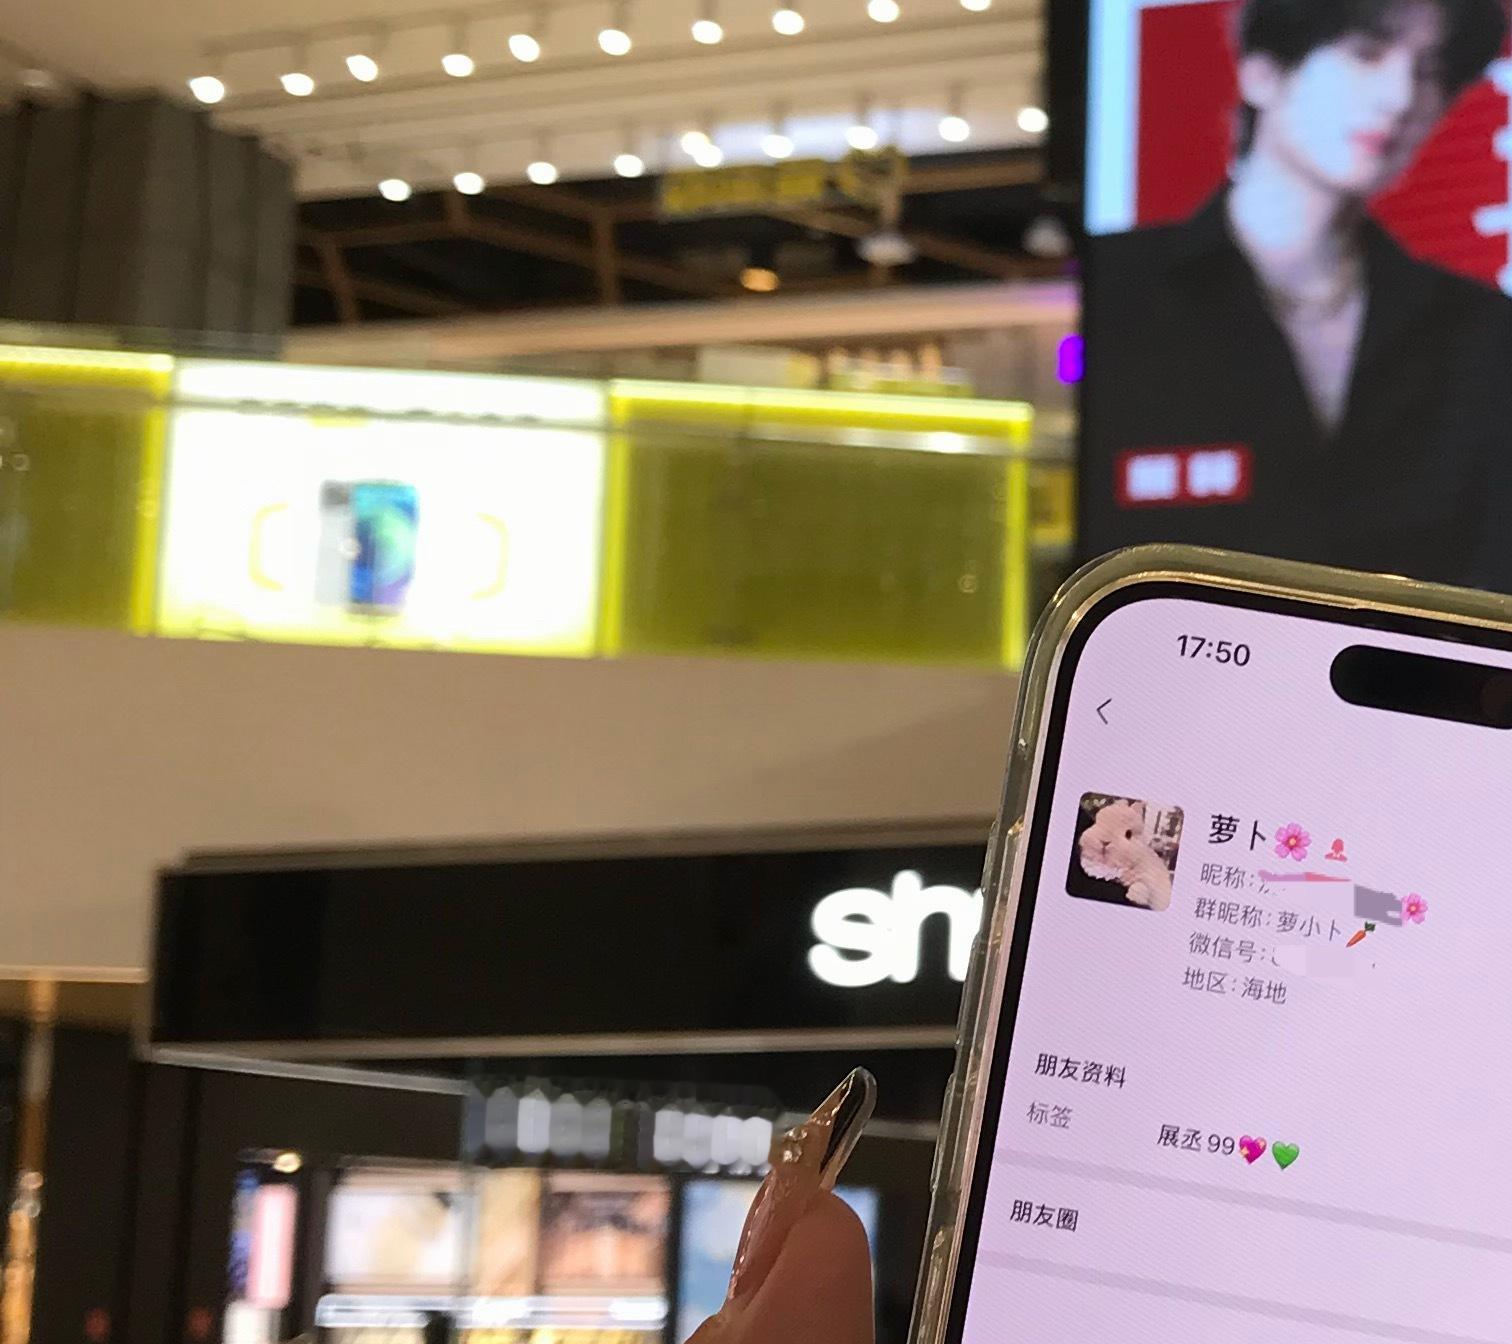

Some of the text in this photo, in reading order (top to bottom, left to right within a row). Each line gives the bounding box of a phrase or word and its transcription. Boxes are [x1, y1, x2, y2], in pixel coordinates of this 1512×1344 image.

[1177, 634, 1251, 667] 17:50
[1207, 813, 1267, 851] 萝卜
[808, 869, 985, 987] sh
[1034, 1053, 1126, 1089] 朋友资料
[1026, 1101, 1073, 1129] 标签
[1009, 1199, 1079, 1232] 朋友圈
